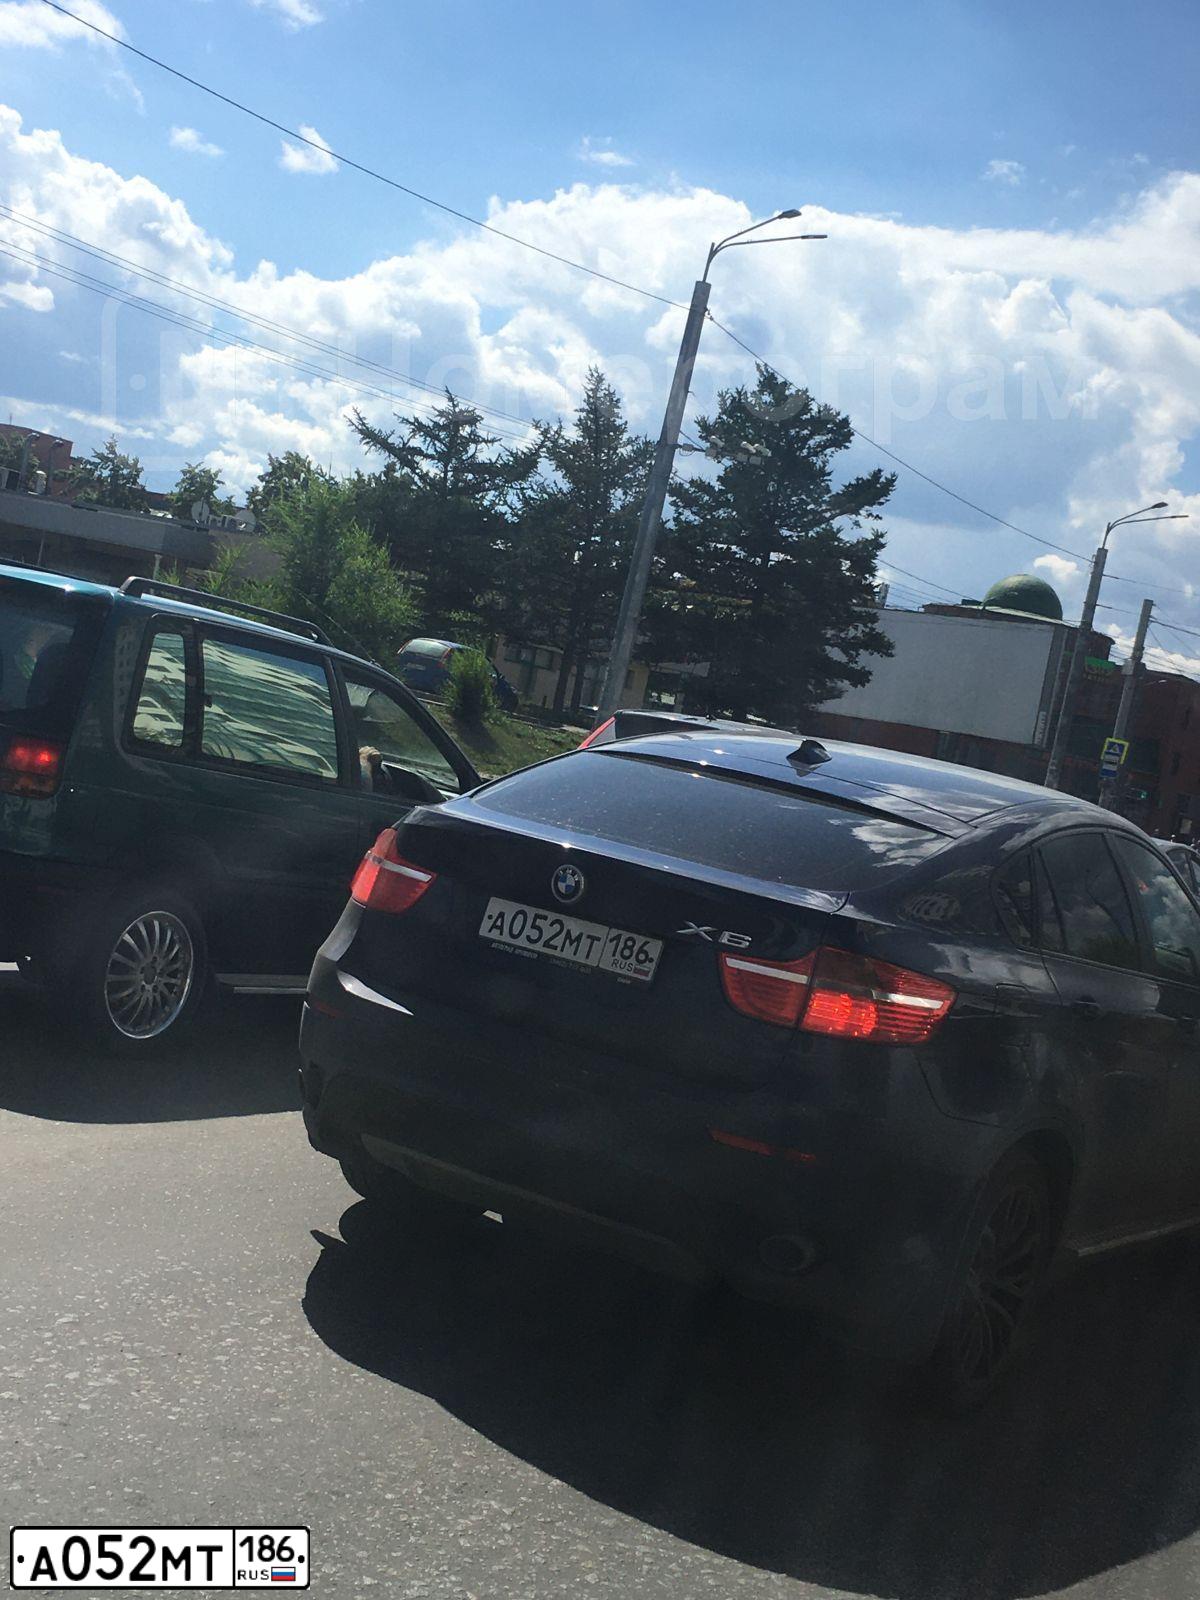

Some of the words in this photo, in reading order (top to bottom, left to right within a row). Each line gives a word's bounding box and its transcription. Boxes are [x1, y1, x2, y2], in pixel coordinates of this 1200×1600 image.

[487, 909, 602, 960] А052МТ
[609, 933, 651, 965] 186
[675, 920, 752, 948] X6
[611, 958, 634, 972] RUS
